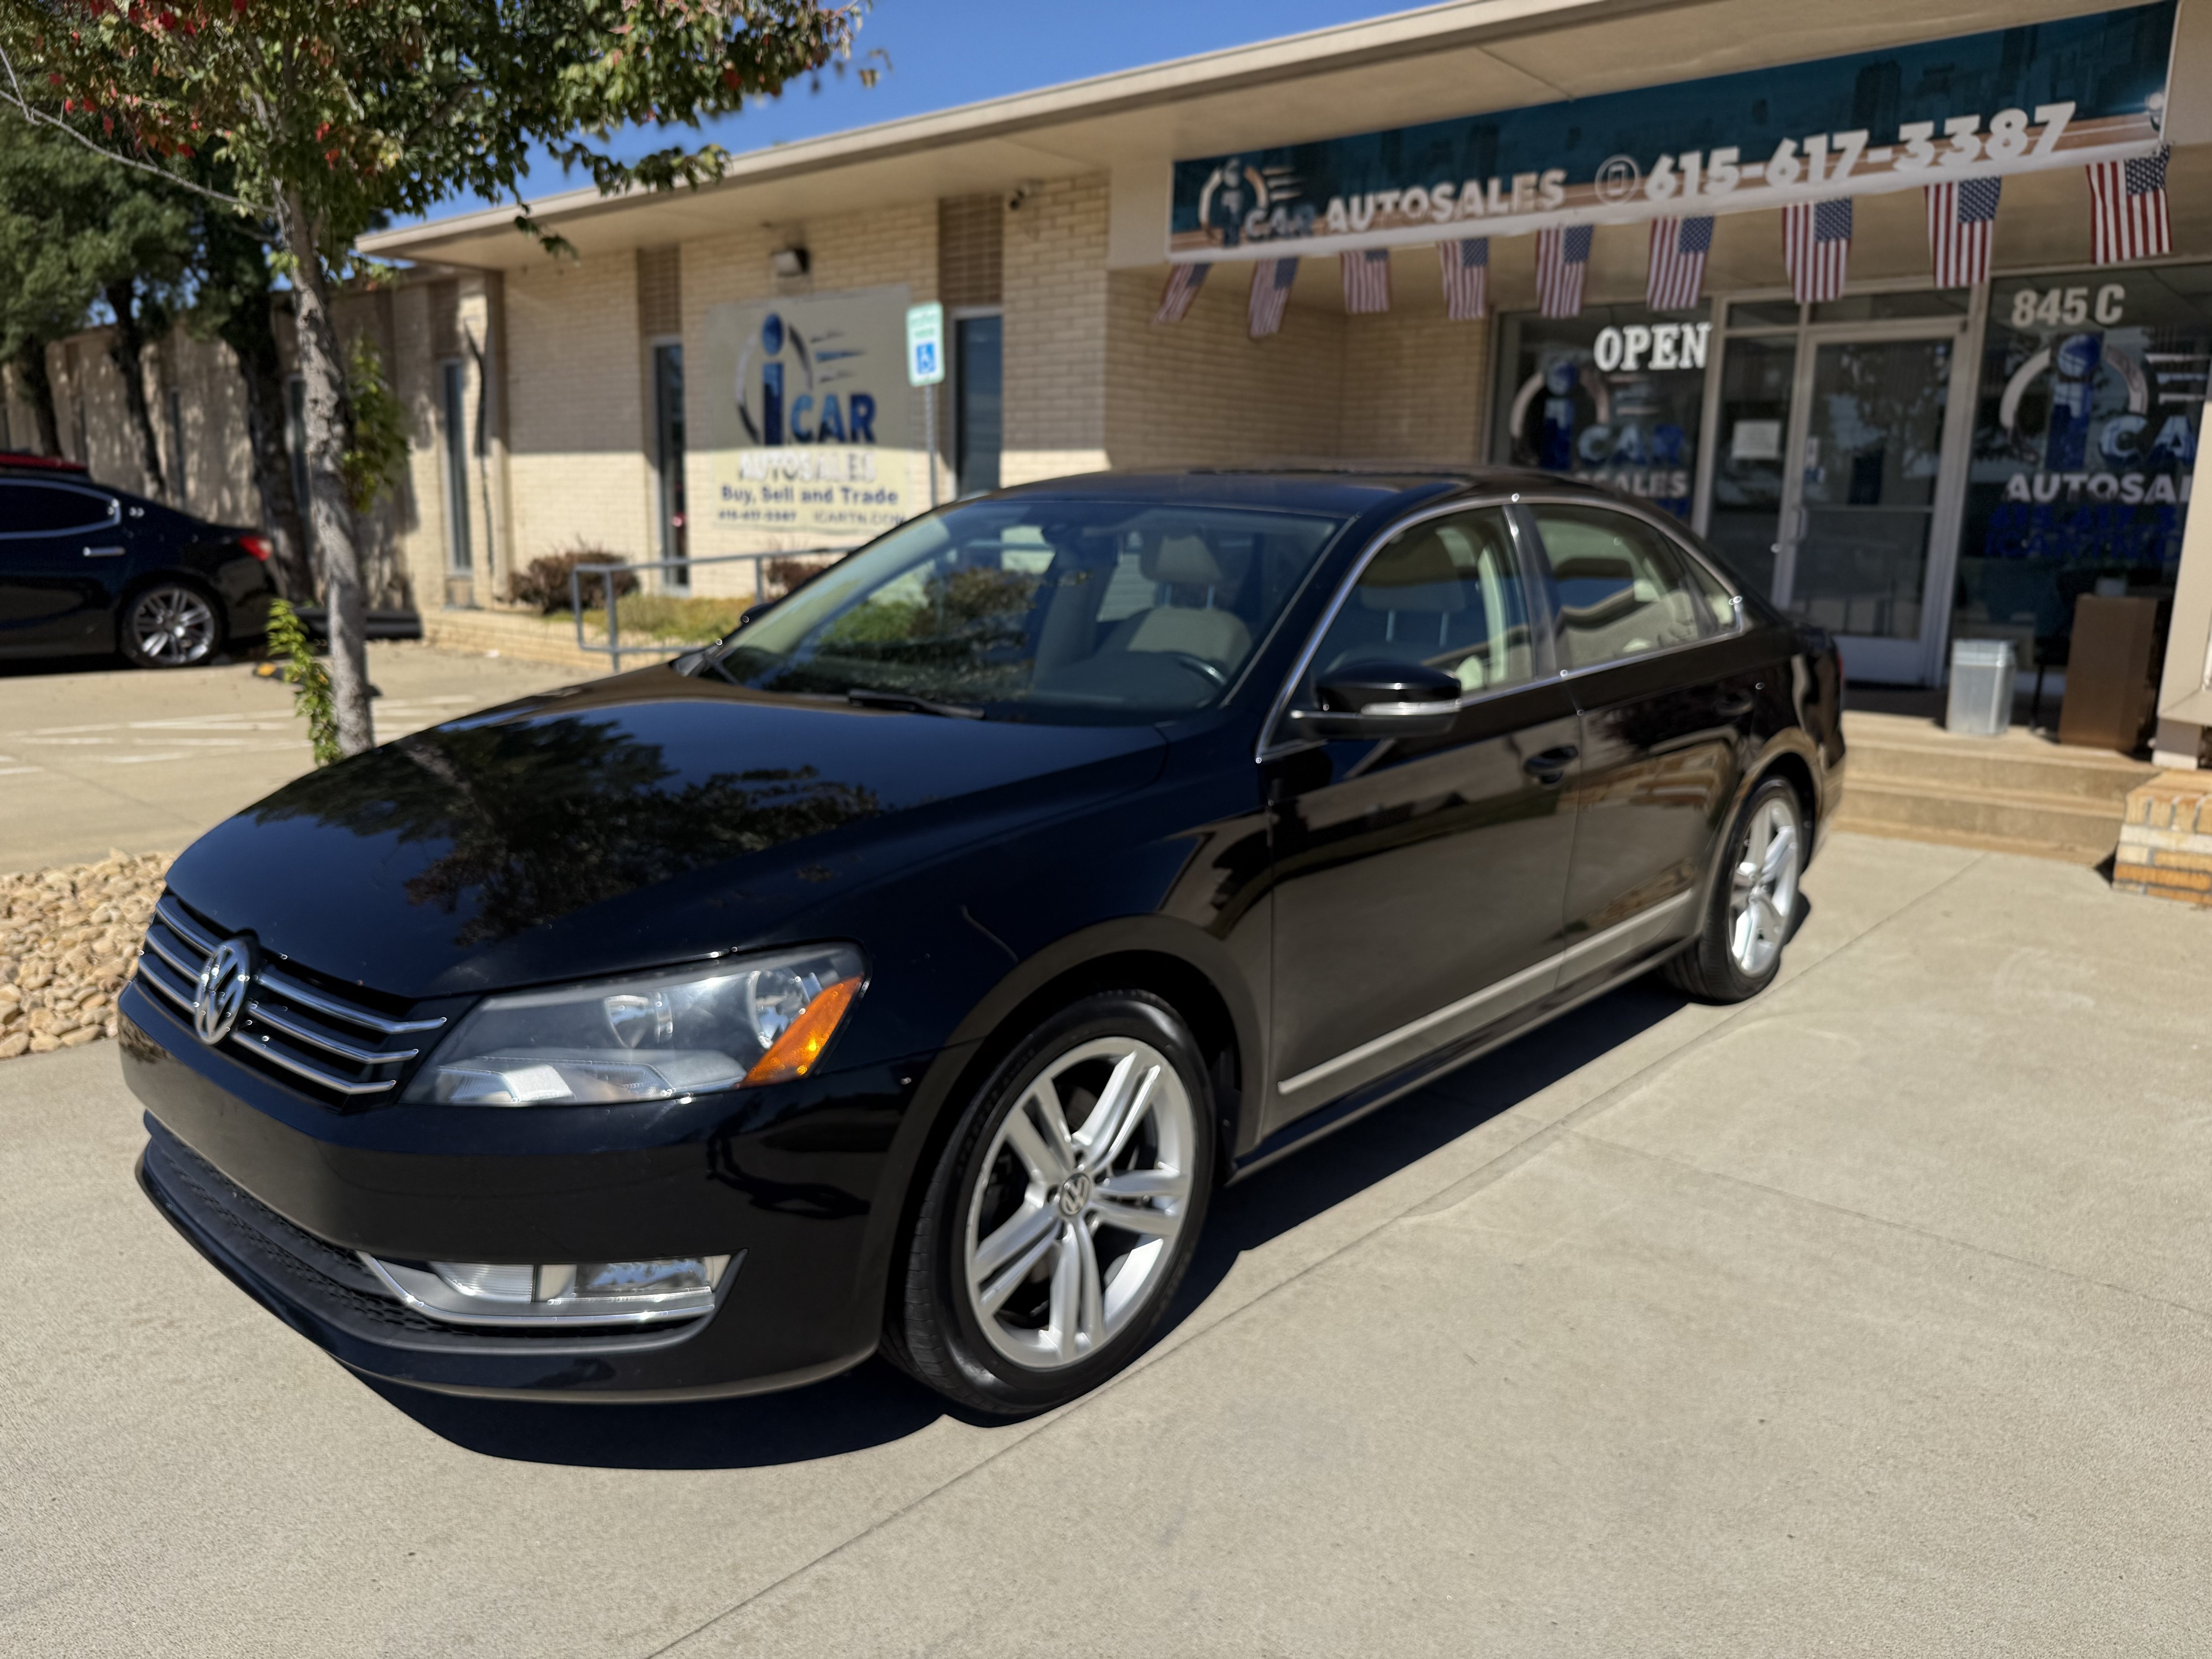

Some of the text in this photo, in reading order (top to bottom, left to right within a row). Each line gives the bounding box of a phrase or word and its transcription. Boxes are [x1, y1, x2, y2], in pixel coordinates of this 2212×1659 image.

[1325, 169, 1567, 233] AUTOSALES
[1644, 101, 2076, 201] 615-617-3387
[2011, 284, 2125, 327] 845 C
[1593, 322, 1712, 372] OPEN
[721, 485, 899, 505] Buy, Sell and Trade
